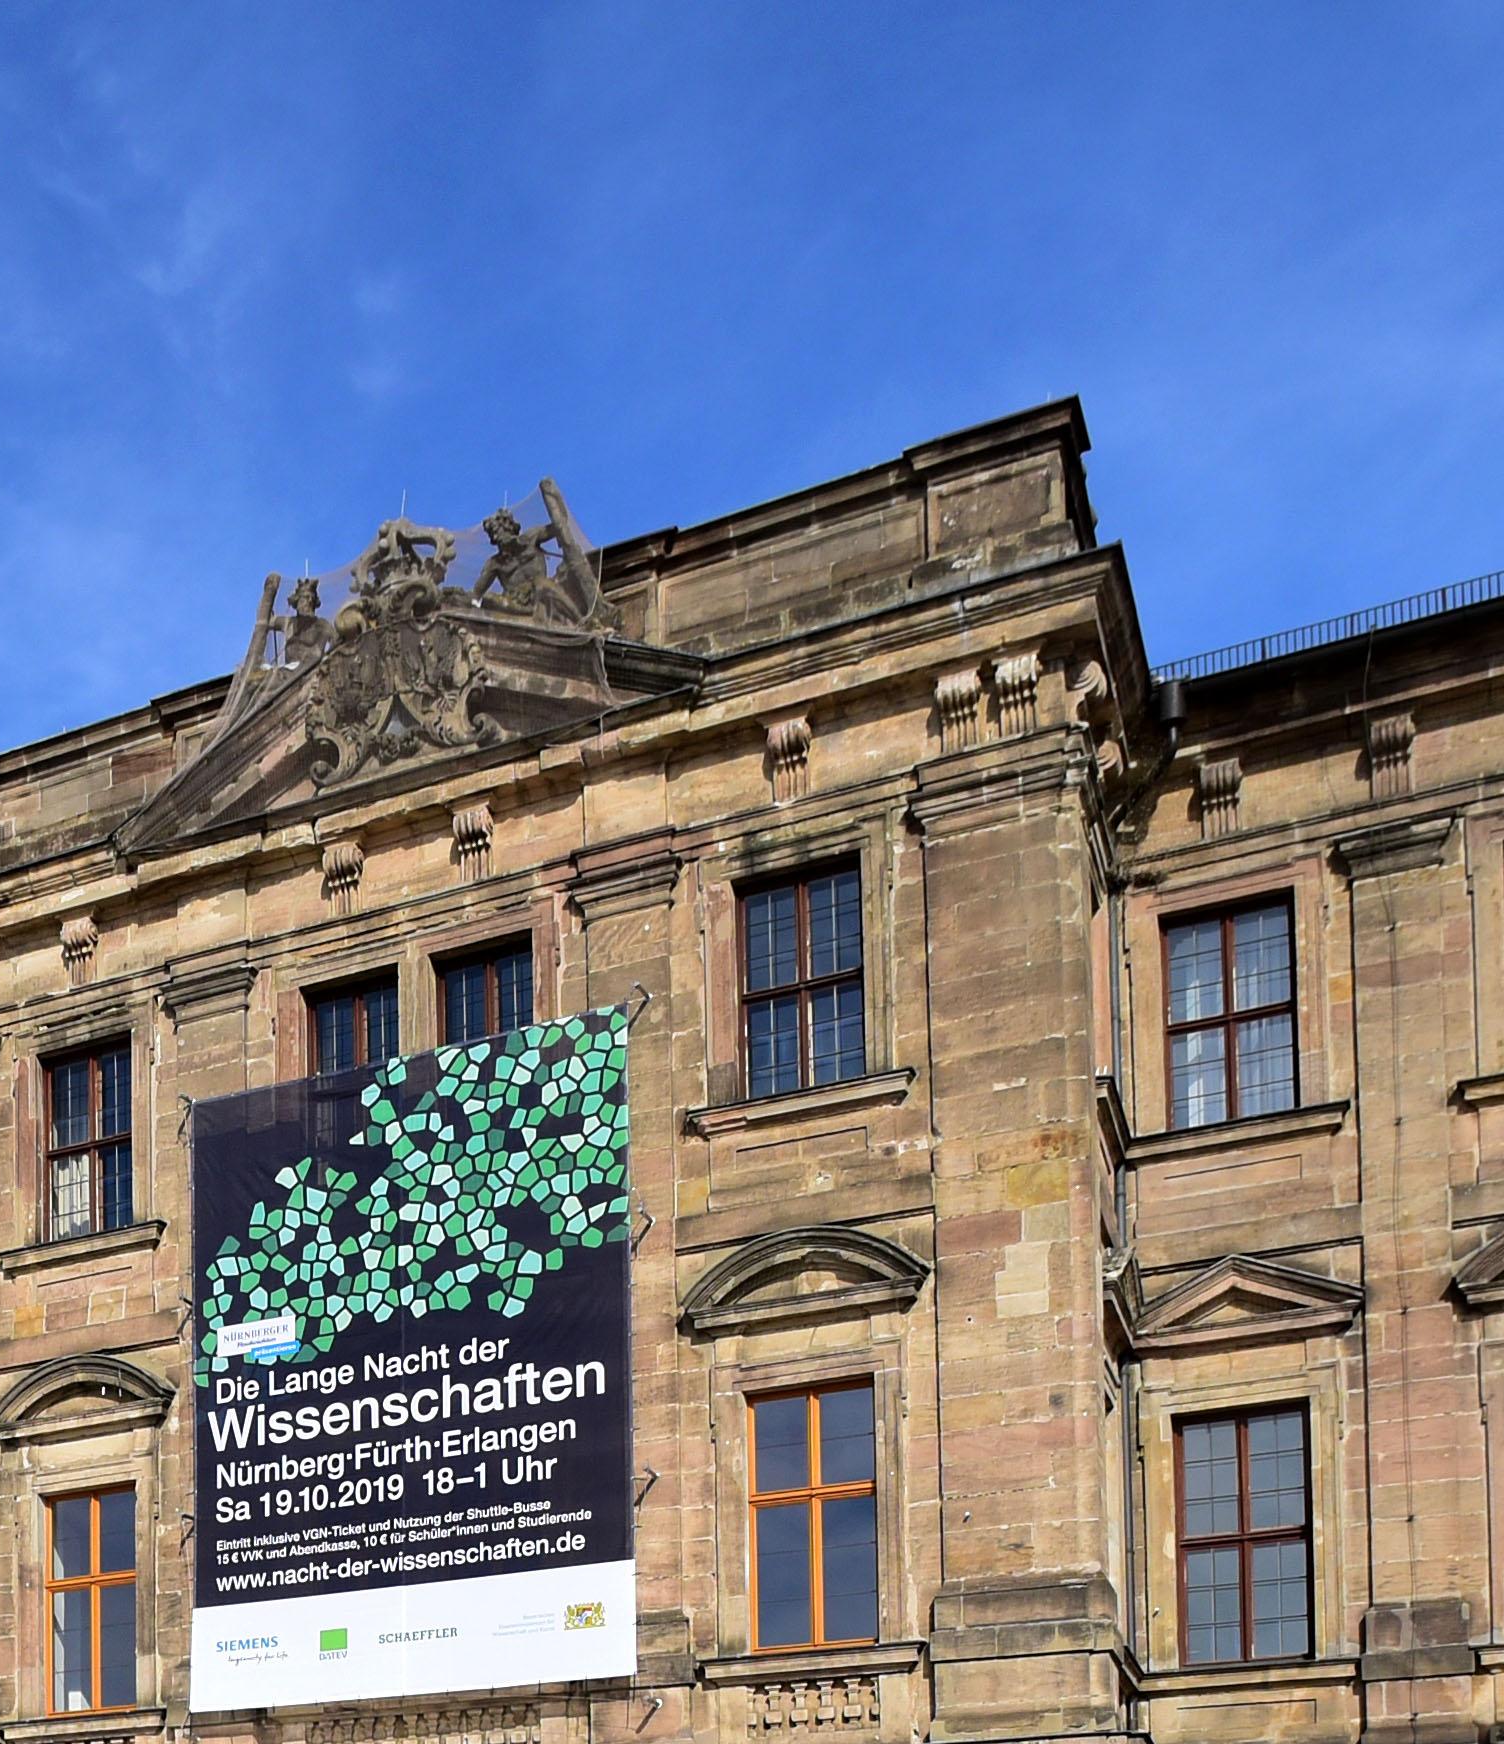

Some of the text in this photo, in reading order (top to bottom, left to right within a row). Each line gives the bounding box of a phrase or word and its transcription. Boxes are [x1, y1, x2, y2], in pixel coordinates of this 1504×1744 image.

[223, 1324, 289, 1343] NÜRNBERGER
[216, 1337, 510, 1404] Die Lange Nacht der
[207, 1361, 605, 1452] Wissenschaften
[215, 1497, 251, 1523] Sa
[259, 1474, 405, 1518] 19.10.2019
[502, 1455, 558, 1485] Uhr
[216, 1500, 551, 1552] Eintritt inklusive VGN-Ticket und Nutzung der Shuttle-Busse
[216, 1554, 229, 1566] 15
[231, 1552, 239, 1563] €
[241, 1549, 264, 1562] VVK
[266, 1546, 287, 1559] und
[289, 1538, 361, 1556] Abendkasse,
[363, 1535, 377, 1548] 10
[379, 1534, 388, 1546] €
[390, 1532, 406, 1544] für
[491, 1518, 515, 1532] und
[517, 1509, 593, 1528] Studierende
[215, 1531, 586, 1592] www.nacht-der-wissenschaften.de
[215, 1636, 279, 1652] SIEMENS
[319, 1649, 348, 1661] DATEV
[378, 1627, 458, 1645] SCHAEFFLER
